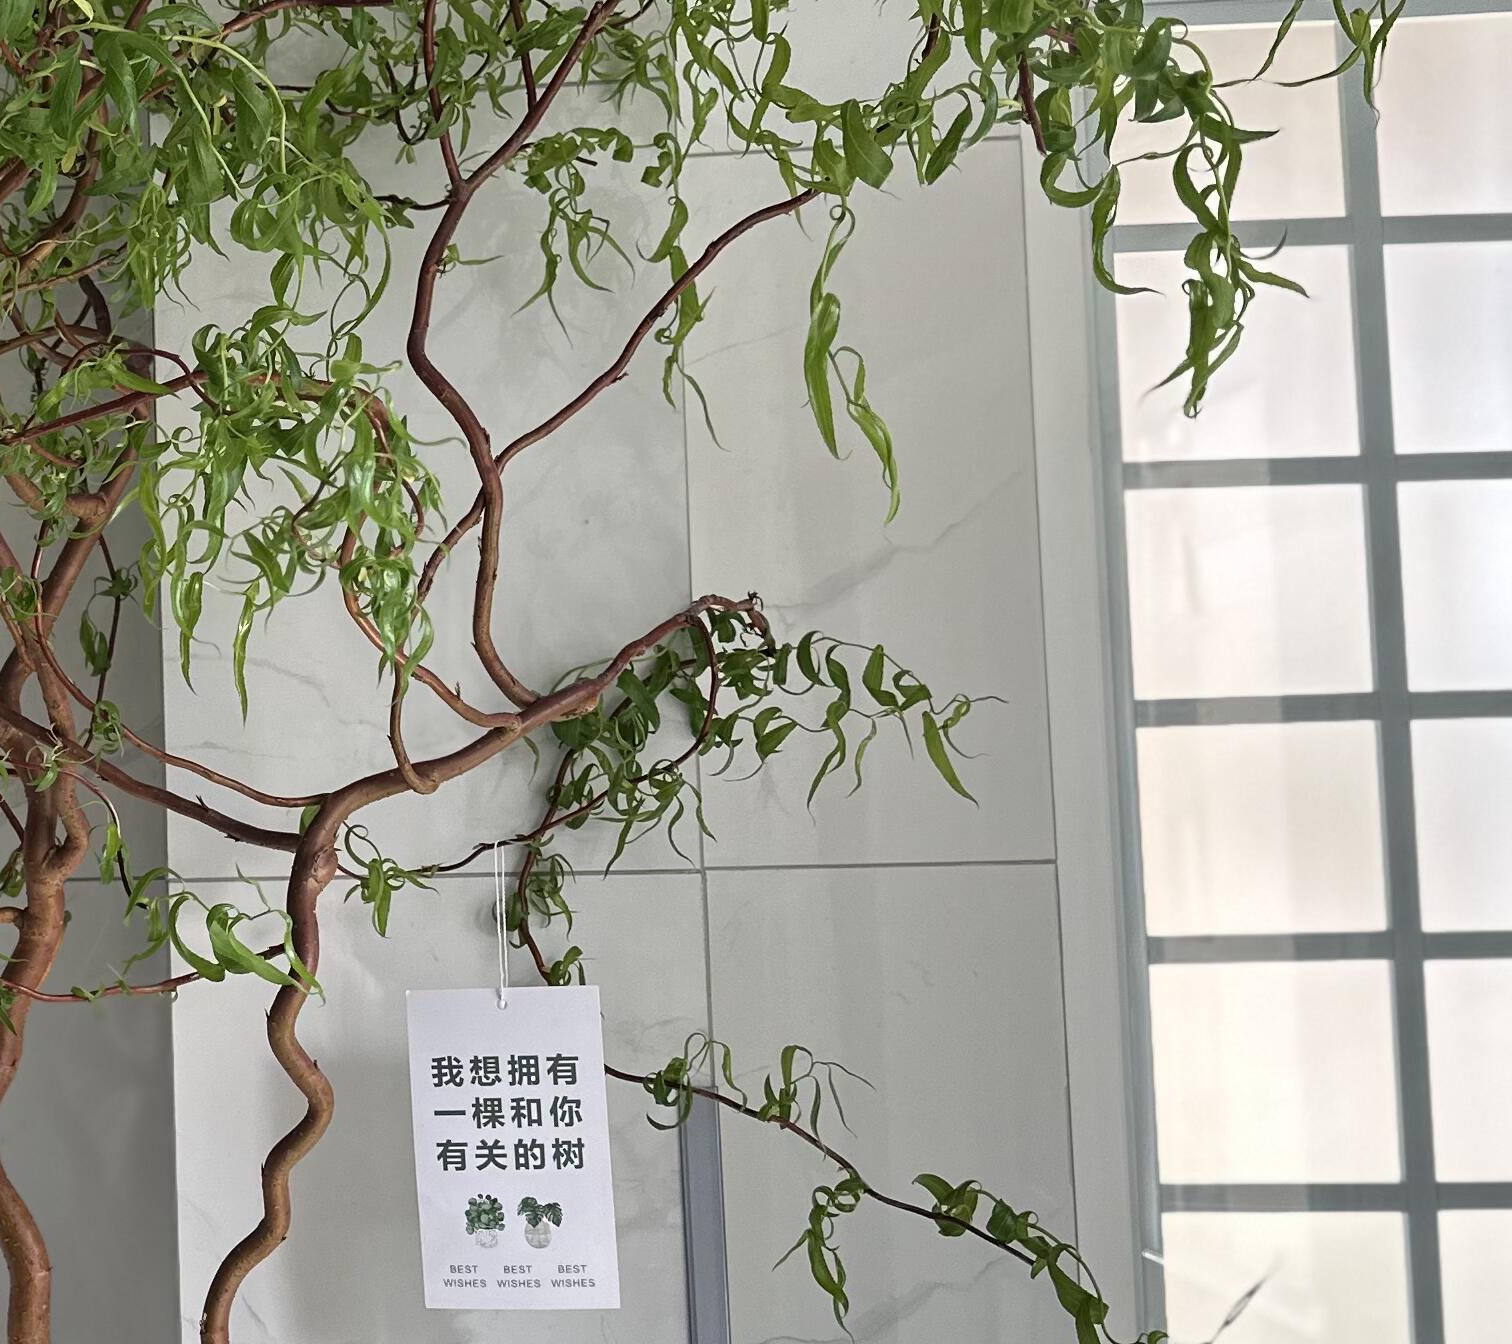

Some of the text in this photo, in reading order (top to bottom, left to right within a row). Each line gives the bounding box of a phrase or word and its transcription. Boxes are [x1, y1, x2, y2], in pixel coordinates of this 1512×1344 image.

[431, 1053, 579, 1088] 我想拥有
[433, 1096, 583, 1129] 一棵和你
[436, 1137, 585, 1171] 有关的树
[443, 1278, 596, 1288] WISHES WISHES WISHES
[449, 1264, 587, 1274] BEST BEST BEST
